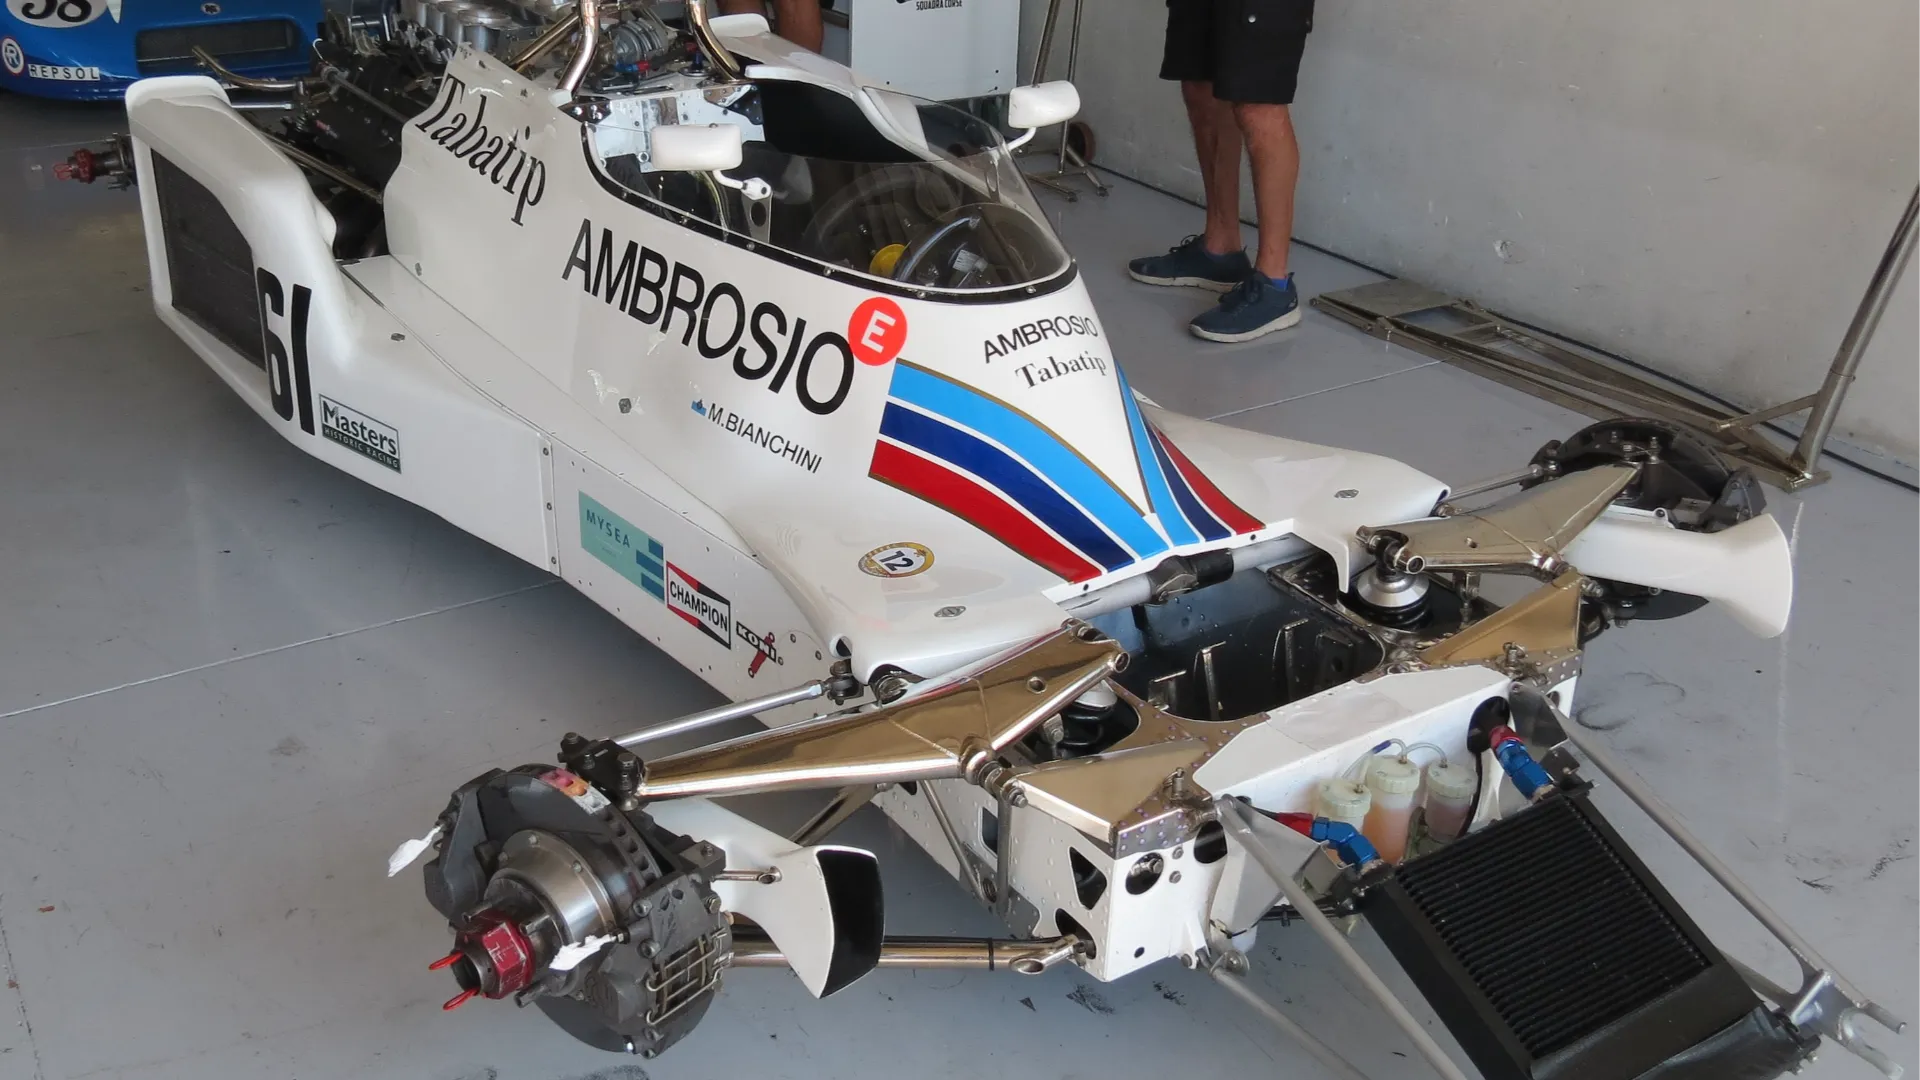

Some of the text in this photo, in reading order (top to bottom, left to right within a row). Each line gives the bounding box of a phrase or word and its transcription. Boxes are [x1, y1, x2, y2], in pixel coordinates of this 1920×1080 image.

[916, 0, 943, 10] SQUADRA
[29, 64, 99, 80] REPSOL
[415, 73, 546, 227] Tabatip
[561, 218, 855, 415] AMBROSIO
[860, 309, 897, 354] E
[257, 266, 315, 436] 61
[984, 315, 1098, 364] AMBROSIO
[1014, 350, 1106, 389] Tabatip
[322, 400, 397, 456] Masters
[324, 427, 398, 468] HISTORIC RACING
[708, 403, 822, 473] M.BIANCHINI
[586, 509, 630, 548] MYSEA
[879, 550, 914, 571] 12
[669, 580, 728, 632] CHAMPION
[737, 621, 776, 663] KONI
